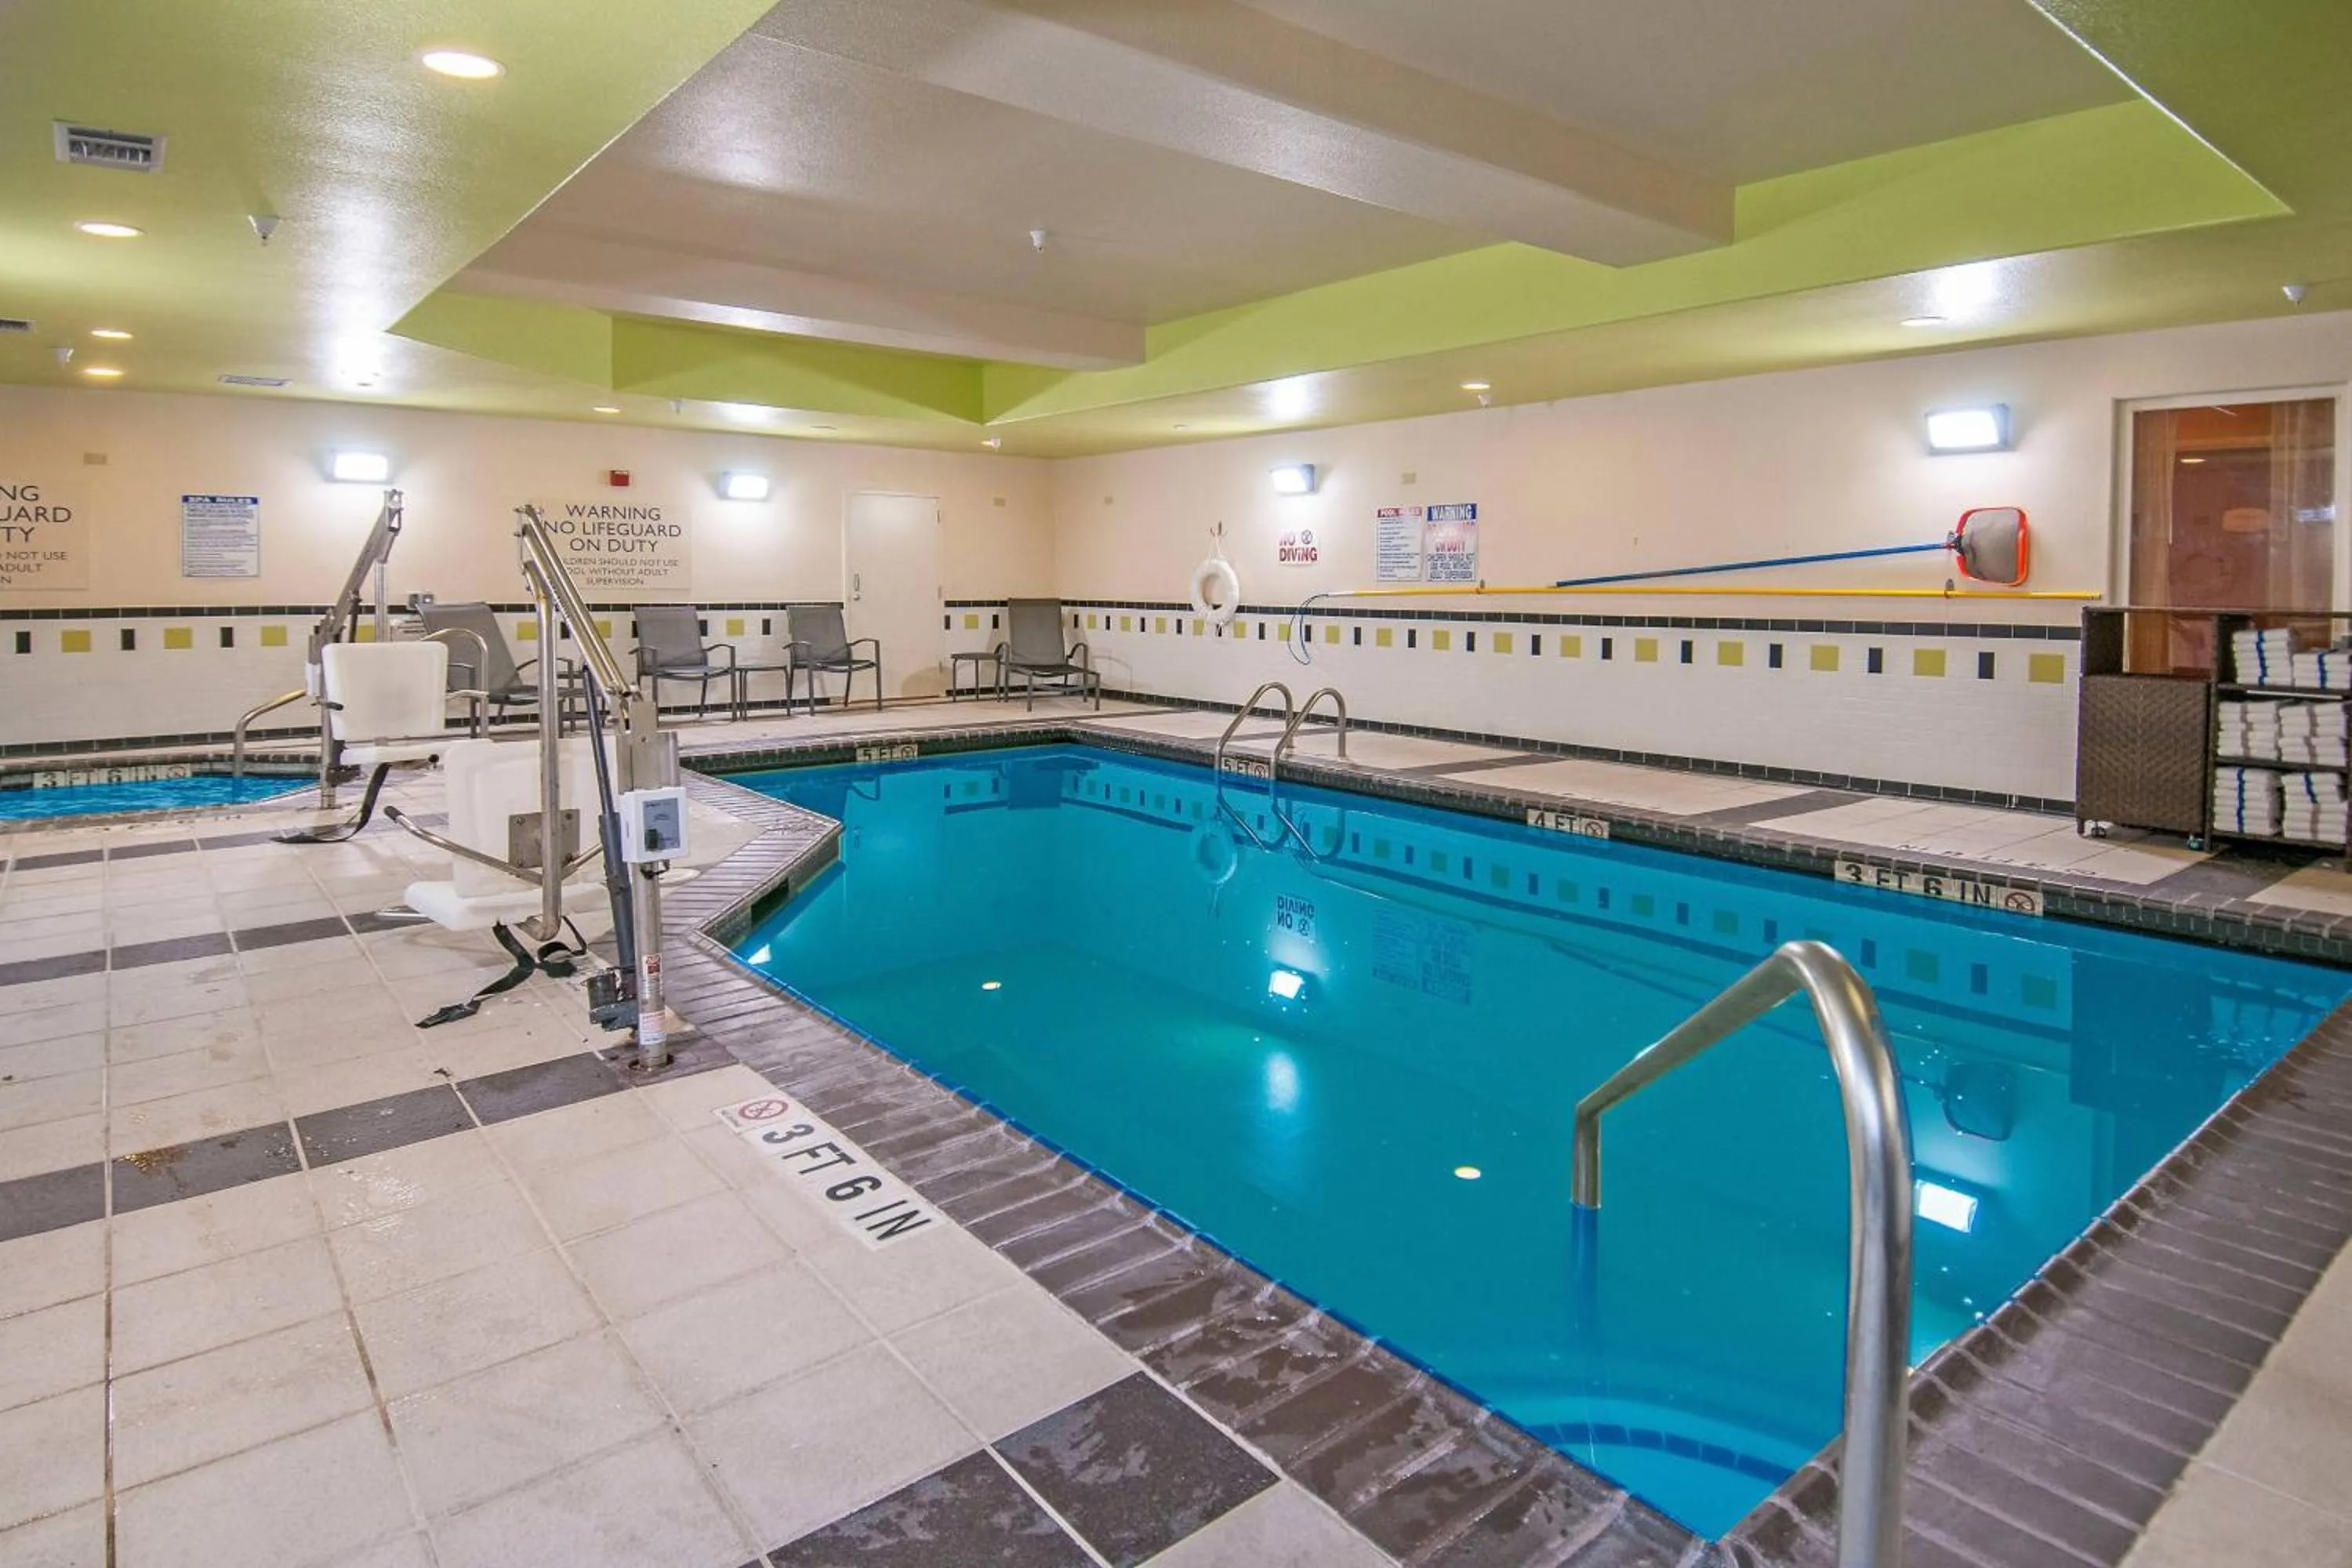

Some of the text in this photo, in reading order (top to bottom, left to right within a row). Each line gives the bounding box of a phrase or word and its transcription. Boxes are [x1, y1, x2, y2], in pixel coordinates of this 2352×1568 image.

[565, 504, 661, 521] WARNING
[1432, 503, 1472, 520] WARNING
[543, 520, 681, 537] NO LIFEGUARD
[570, 538, 658, 553] ON DUTY
[1279, 546, 1318, 561] DIVING
[6, 551, 67, 560] NOT USE
[598, 557, 637, 566] SHOULD
[42, 765, 157, 787] 3 FT 6 IN
[1555, 814, 1577, 832] FT
[1845, 863, 1991, 904] 3 FT 6 IN
[762, 1123, 932, 1241] 3 FT 6 IN
